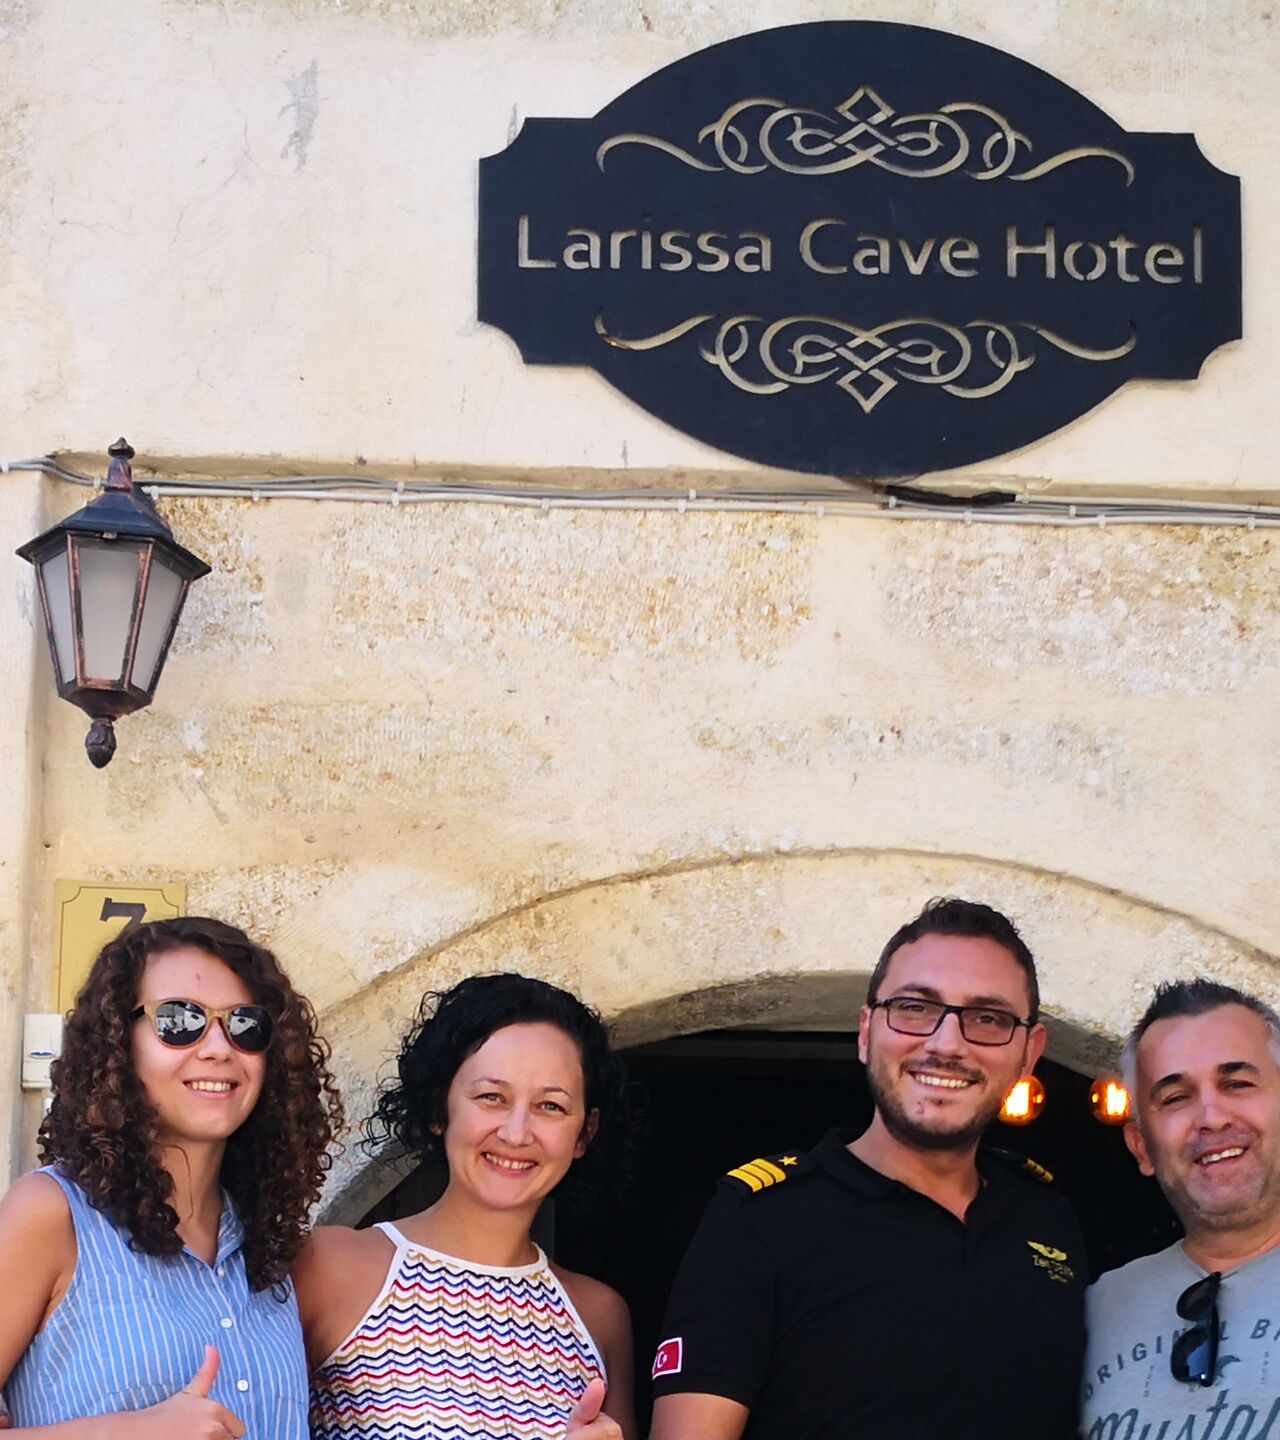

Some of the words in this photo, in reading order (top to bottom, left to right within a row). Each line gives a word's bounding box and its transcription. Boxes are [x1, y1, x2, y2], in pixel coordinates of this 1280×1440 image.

[517, 213, 773, 274] Larissa
[798, 217, 980, 279] Cave
[1006, 223, 1203, 285] Hotel
[99, 897, 147, 940] 7
